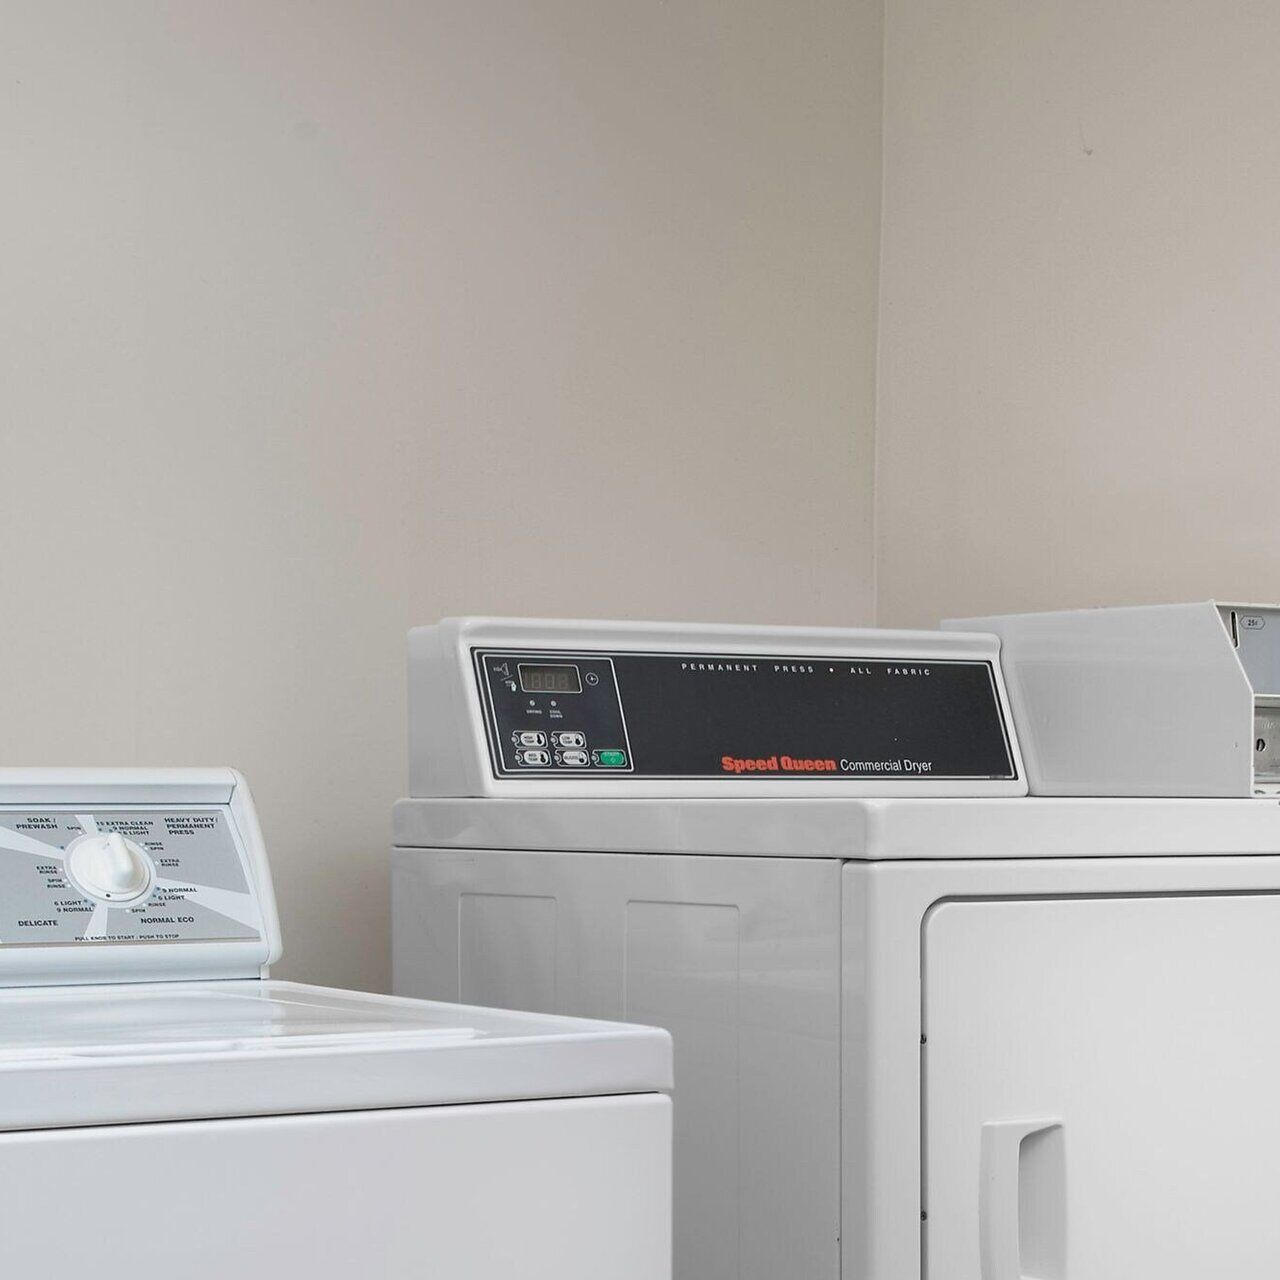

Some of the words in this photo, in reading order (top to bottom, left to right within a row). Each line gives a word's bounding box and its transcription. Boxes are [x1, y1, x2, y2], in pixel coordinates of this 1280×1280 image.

[680, 662, 758, 672] PERMANENT
[774, 665, 815, 674] PRESS
[850, 667, 872, 675] ALL
[886, 667, 931, 676] FABRIC
[721, 756, 779, 774] Speed
[780, 755, 838, 772] Queen
[840, 758, 903, 772] Commercial
[904, 759, 933, 774] Dryer
